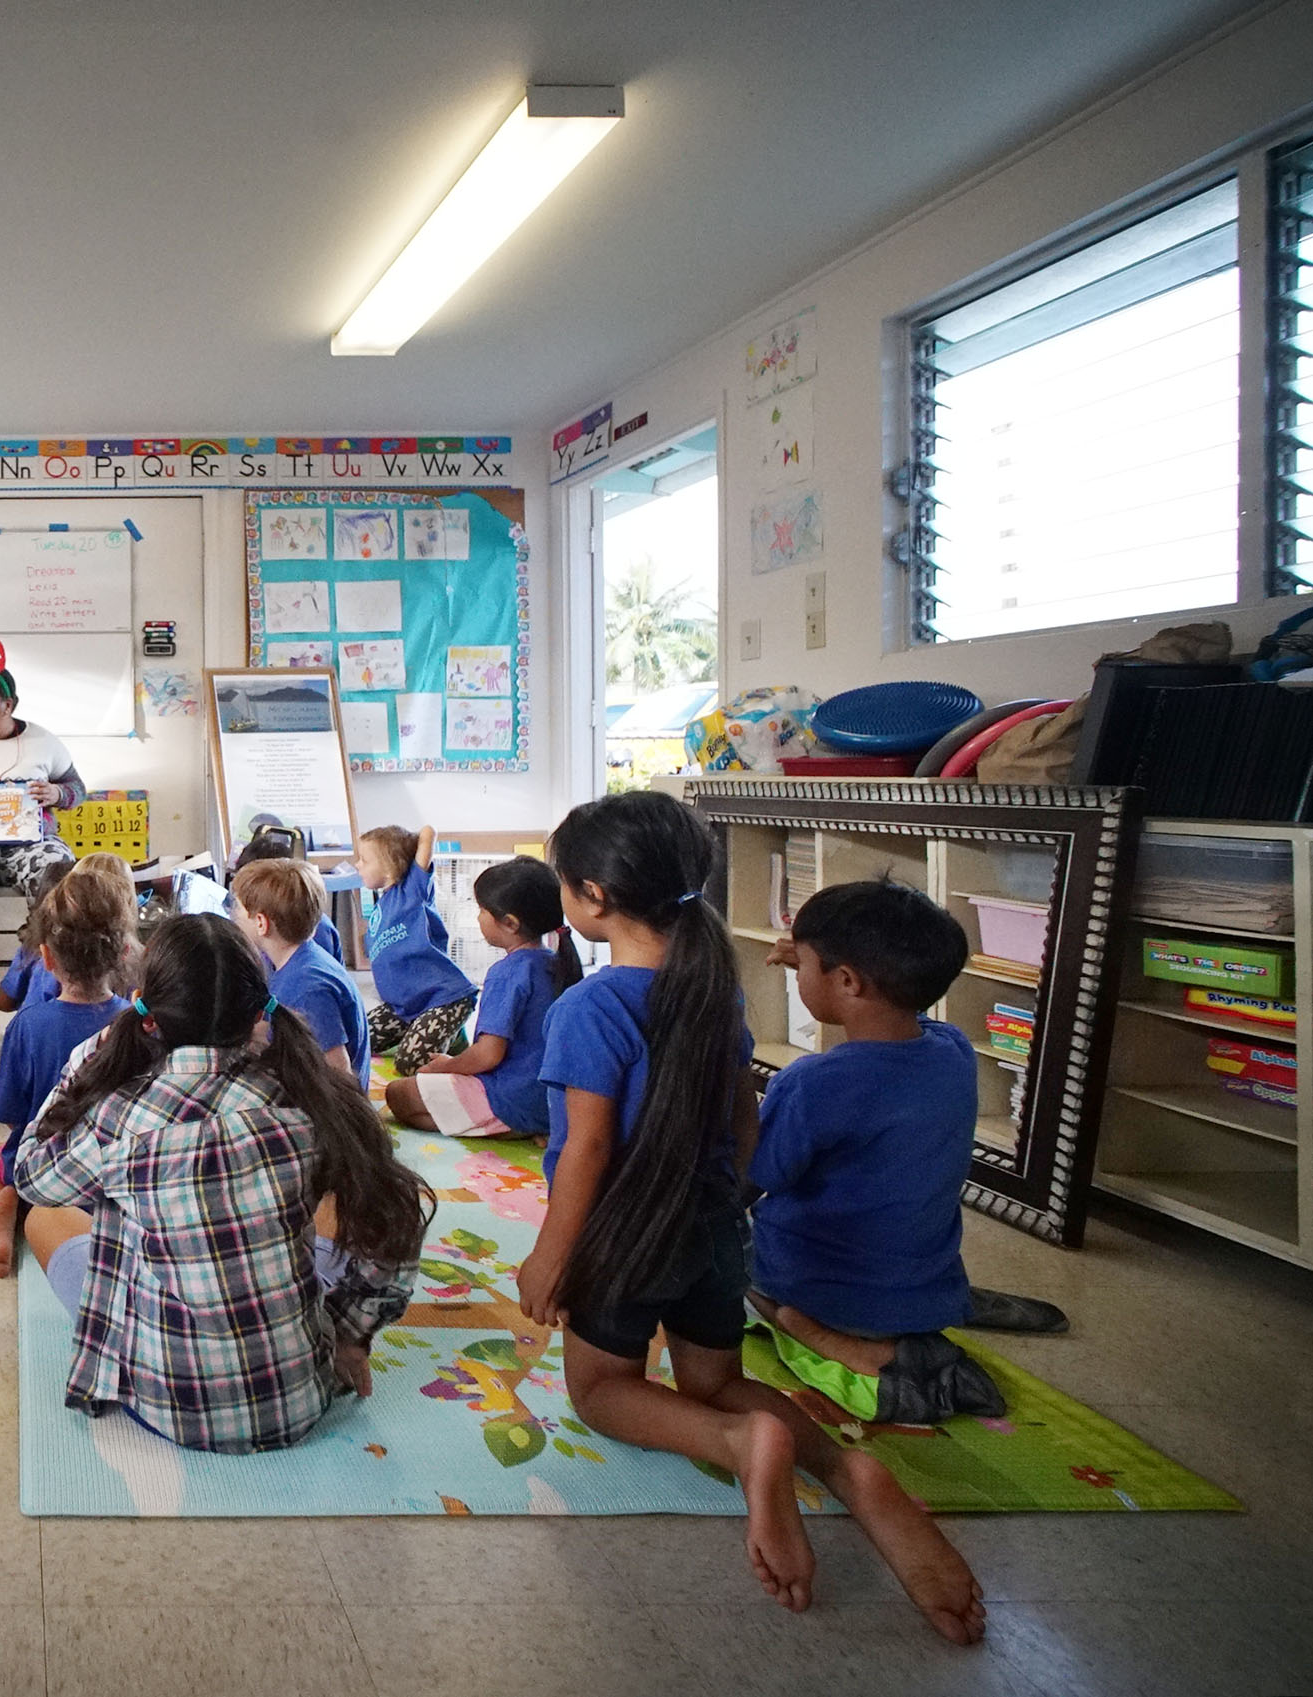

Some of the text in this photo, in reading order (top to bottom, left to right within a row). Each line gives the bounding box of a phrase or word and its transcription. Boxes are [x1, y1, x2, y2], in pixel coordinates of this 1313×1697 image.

[621, 421, 640, 436] EXIT
[557, 427, 603, 476] Yy Zz
[1, 456, 31, 479] Nn
[44, 456, 80, 478] Oo
[95, 456, 125, 488] Pp
[141, 455, 175, 478] Qu
[191, 454, 220, 477] Rr
[239, 454, 267, 477] Ss
[285, 453, 314, 477] Tt
[332, 453, 361, 477] Uu
[381, 453, 407, 477] Vv
[420, 453, 462, 477] Ww
[472, 453, 503, 477] Xx
[78, 536, 97, 552] 20
[76, 804, 143, 818] 2 3 4 5
[76, 824, 83, 836] 9
[94, 822, 107, 835] 10
[113, 820, 124, 833] 11
[129, 820, 141, 832] 12
[1152, 952, 1266, 975] WHAT'S THE ORDER?
[1169, 964, 1246, 981] SEQUENCING KIT
[1207, 993, 1268, 1010] Rhyming
